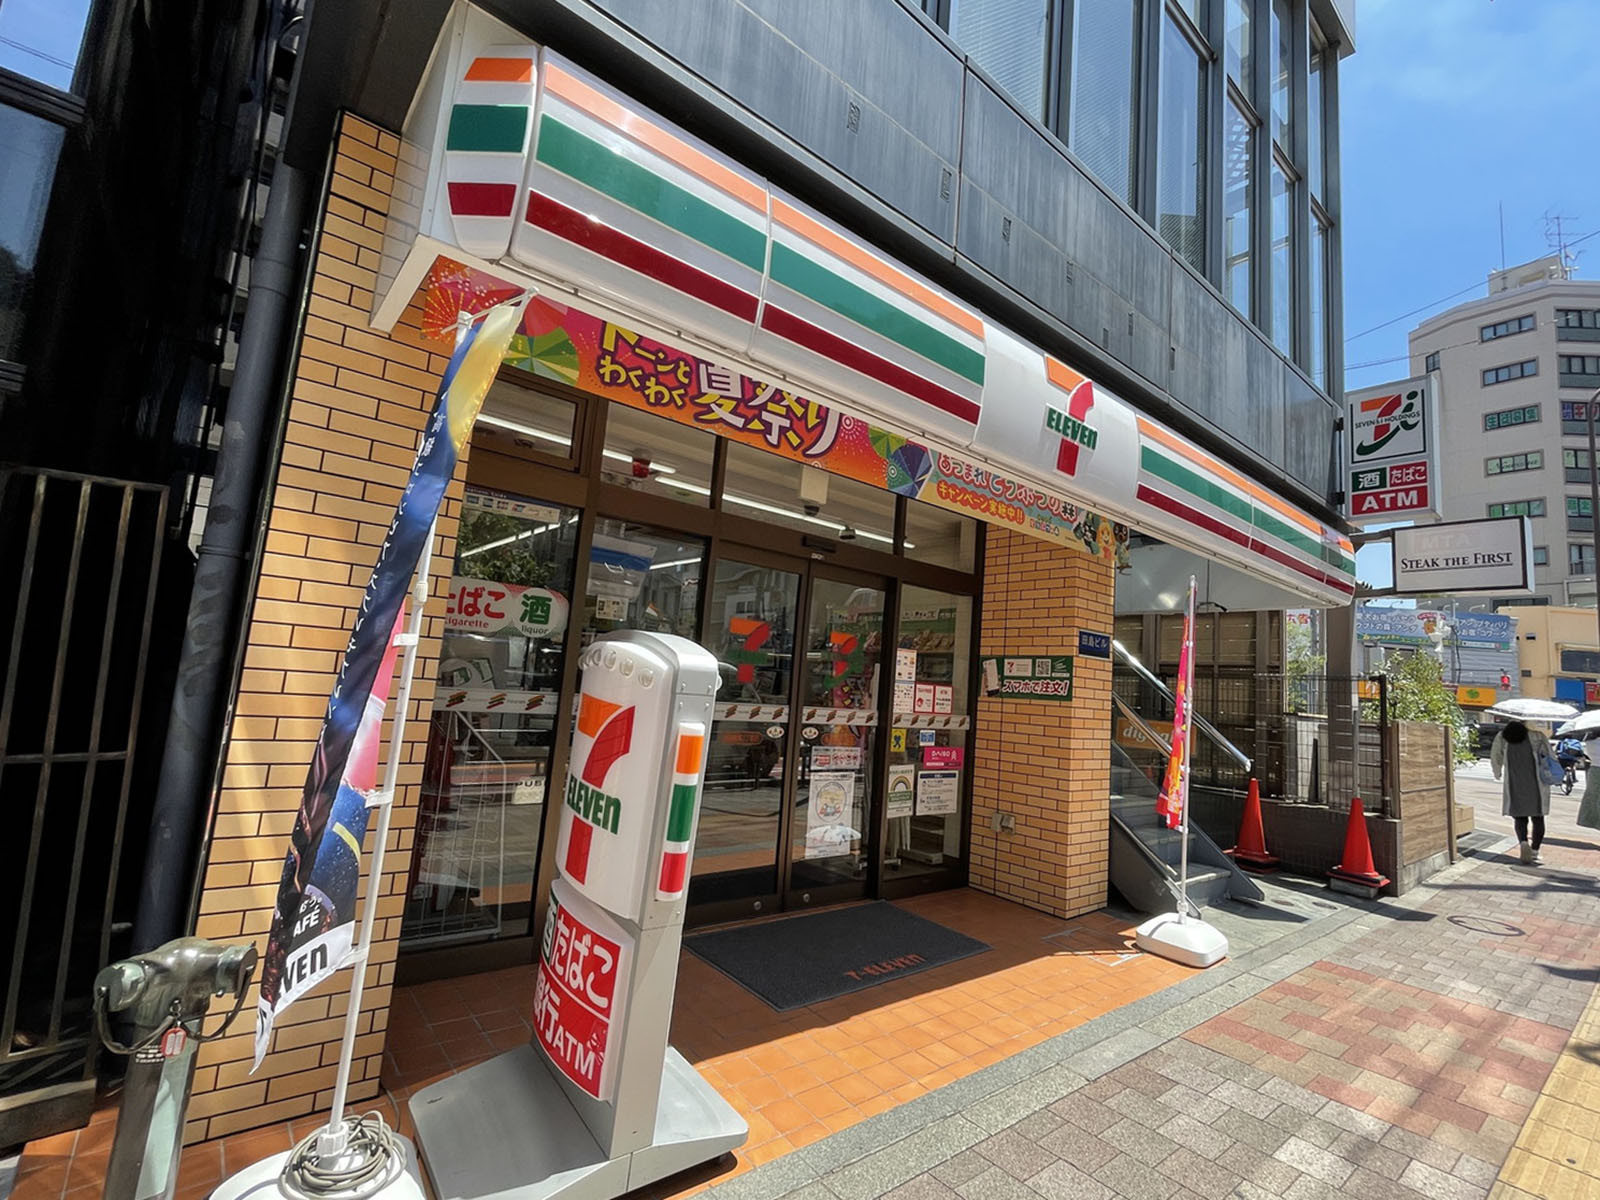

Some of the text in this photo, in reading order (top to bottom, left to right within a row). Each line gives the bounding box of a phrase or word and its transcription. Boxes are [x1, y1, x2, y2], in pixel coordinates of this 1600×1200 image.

[599, 355, 686, 407] わくわく
[1358, 472, 1381, 490] 酒
[1391, 466, 1427, 484] たばこ
[1361, 490, 1418, 512] ATM
[519, 593, 552, 625] 酒
[445, 617, 489, 628] igarette
[521, 625, 549, 635] liquor
[552, 914, 613, 1009] たばこ
